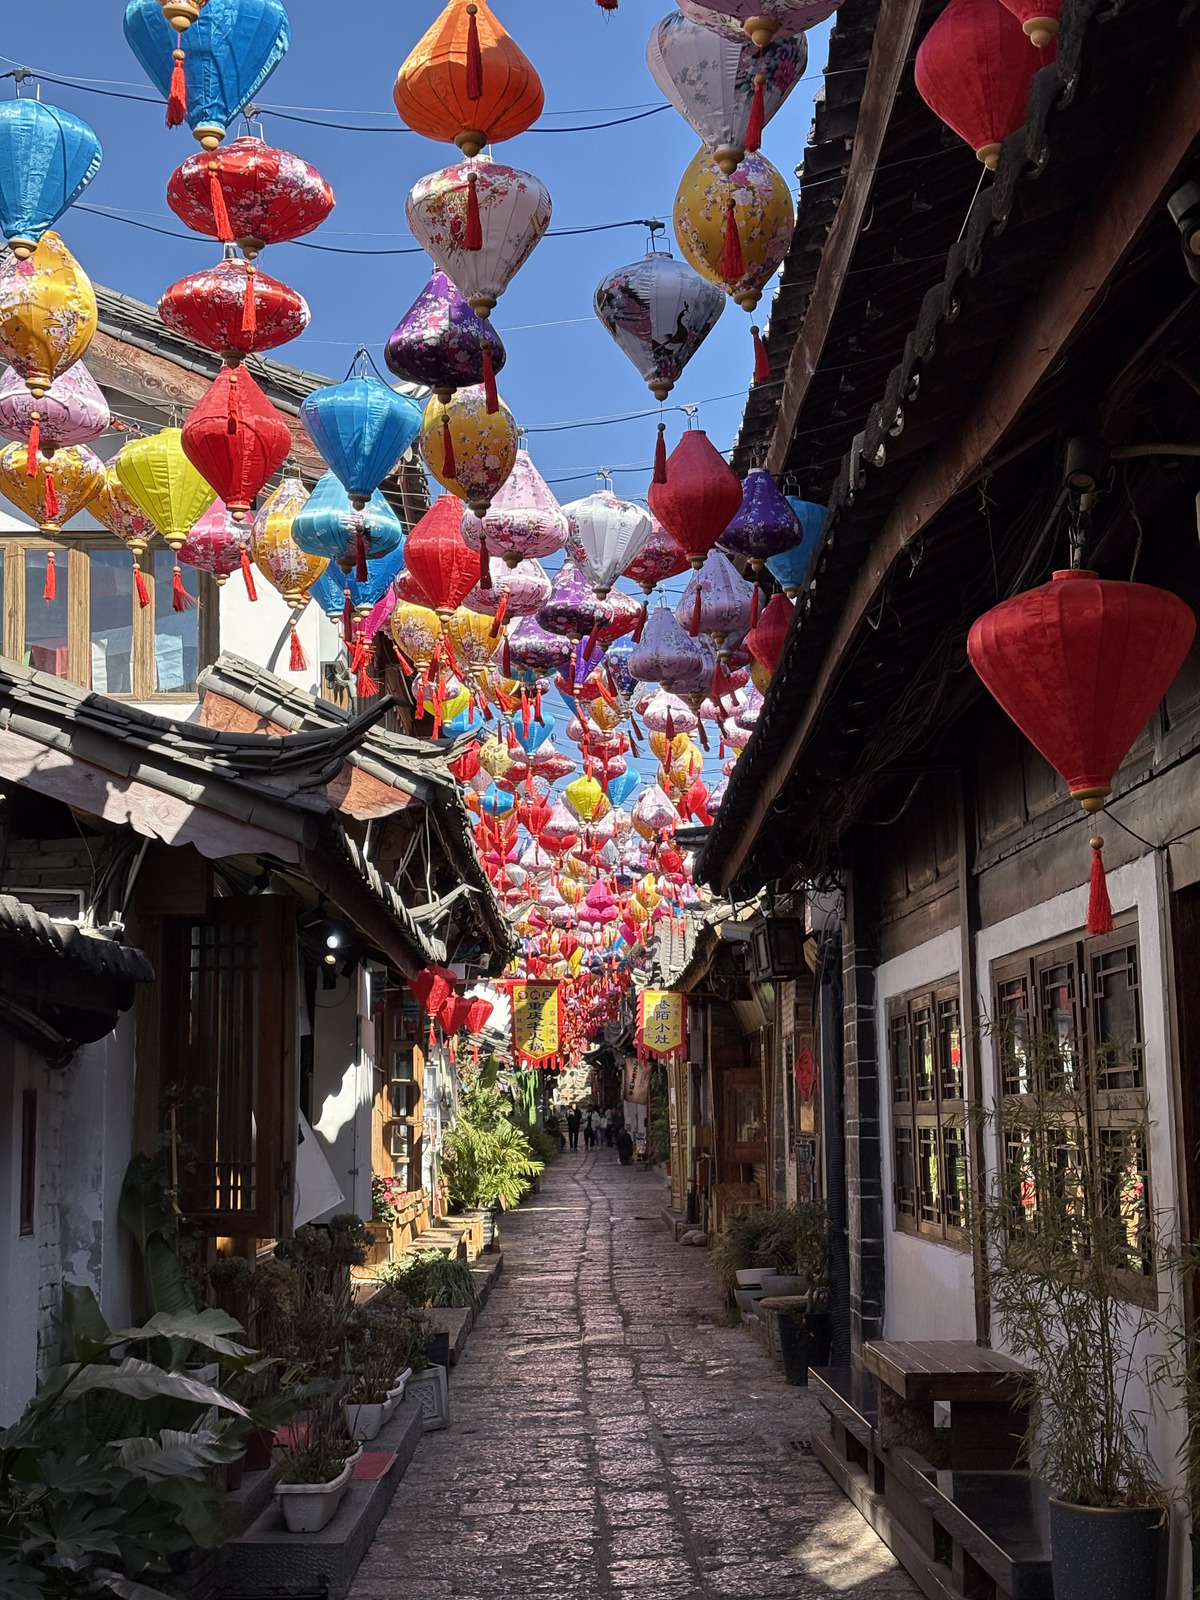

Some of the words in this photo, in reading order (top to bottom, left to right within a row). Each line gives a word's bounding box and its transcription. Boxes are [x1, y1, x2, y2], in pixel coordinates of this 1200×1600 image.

[526, 1001, 545, 1052] 重庆老火锅
[655, 999, 671, 1044] 巷陌小灶
